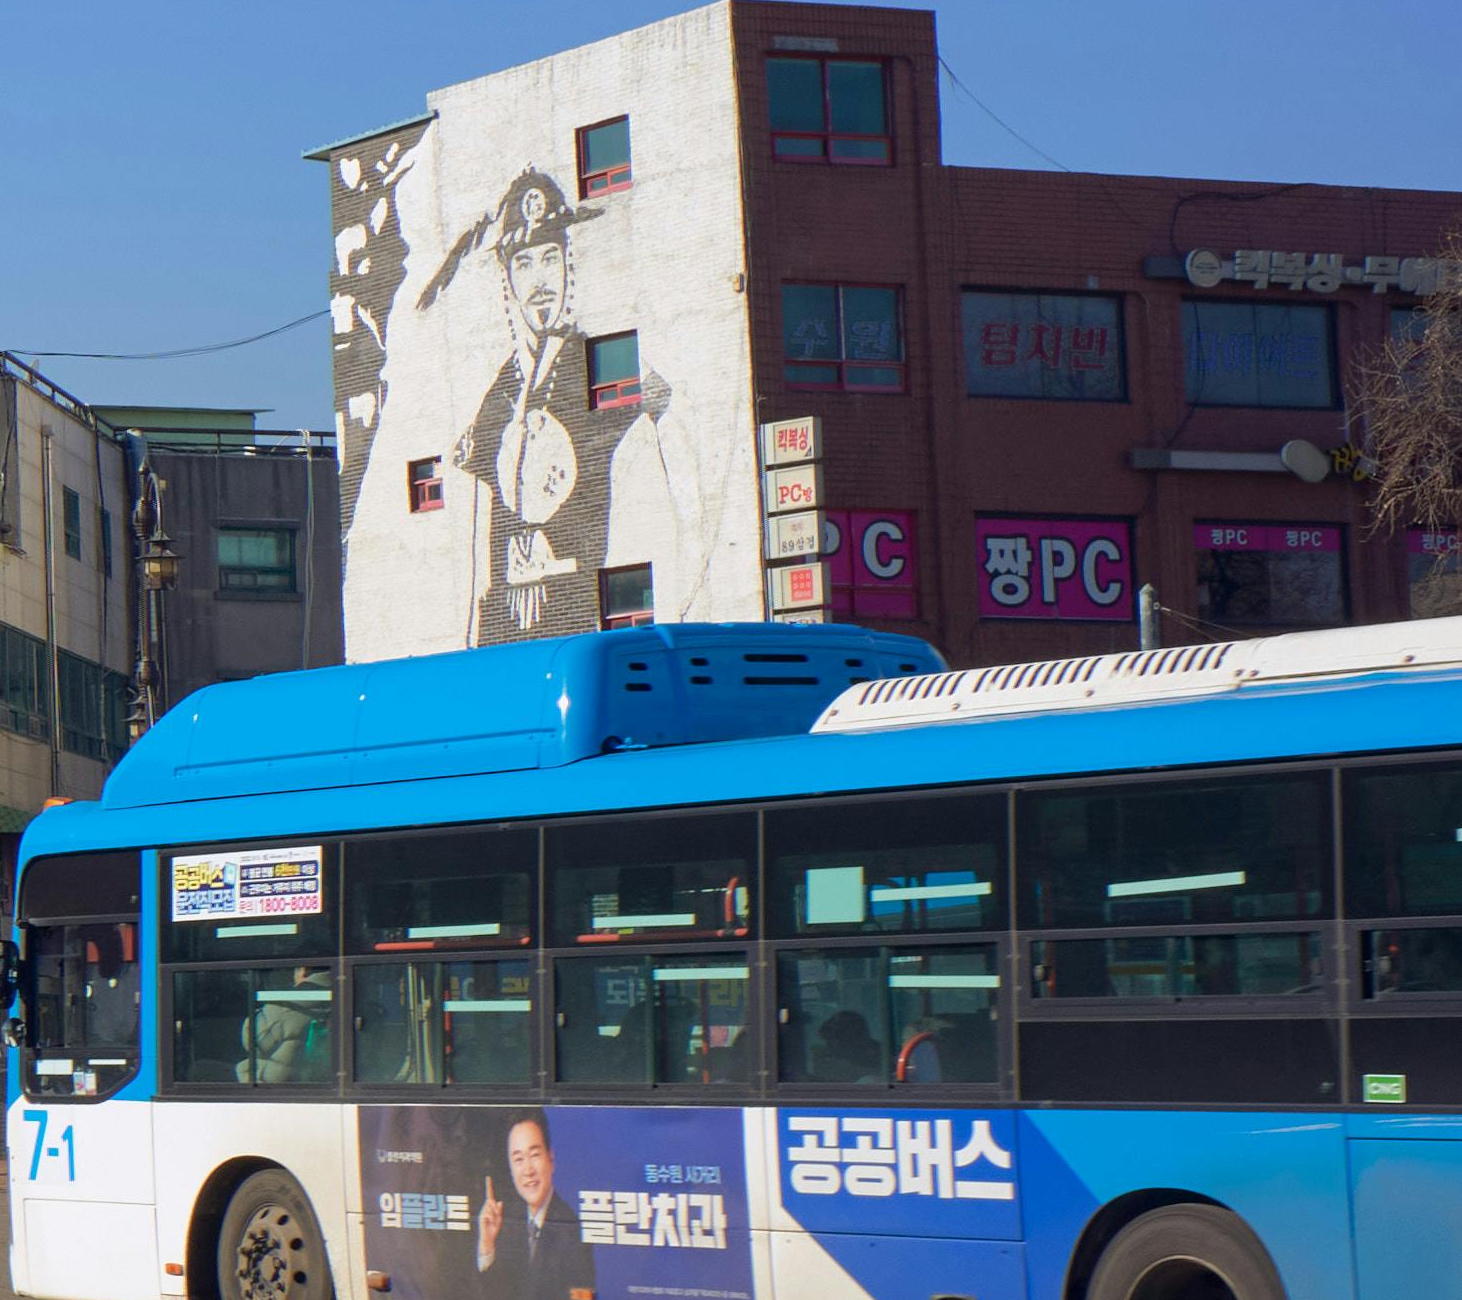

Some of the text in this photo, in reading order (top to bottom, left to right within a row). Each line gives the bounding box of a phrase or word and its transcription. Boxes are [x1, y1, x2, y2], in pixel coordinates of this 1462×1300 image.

[778, 426, 809, 452] 킥복싱
[778, 483, 812, 505] PC방
[984, 535, 1123, 607] 짱PC
[174, 861, 225, 891] 공공버스
[23, 1109, 76, 1183] 7-1
[787, 1116, 1015, 1201] 공공버스
[644, 1163, 722, 1186] 동수원 사거리
[379, 1192, 472, 1231] 임플란트
[578, 1189, 728, 1250] 플란치과
